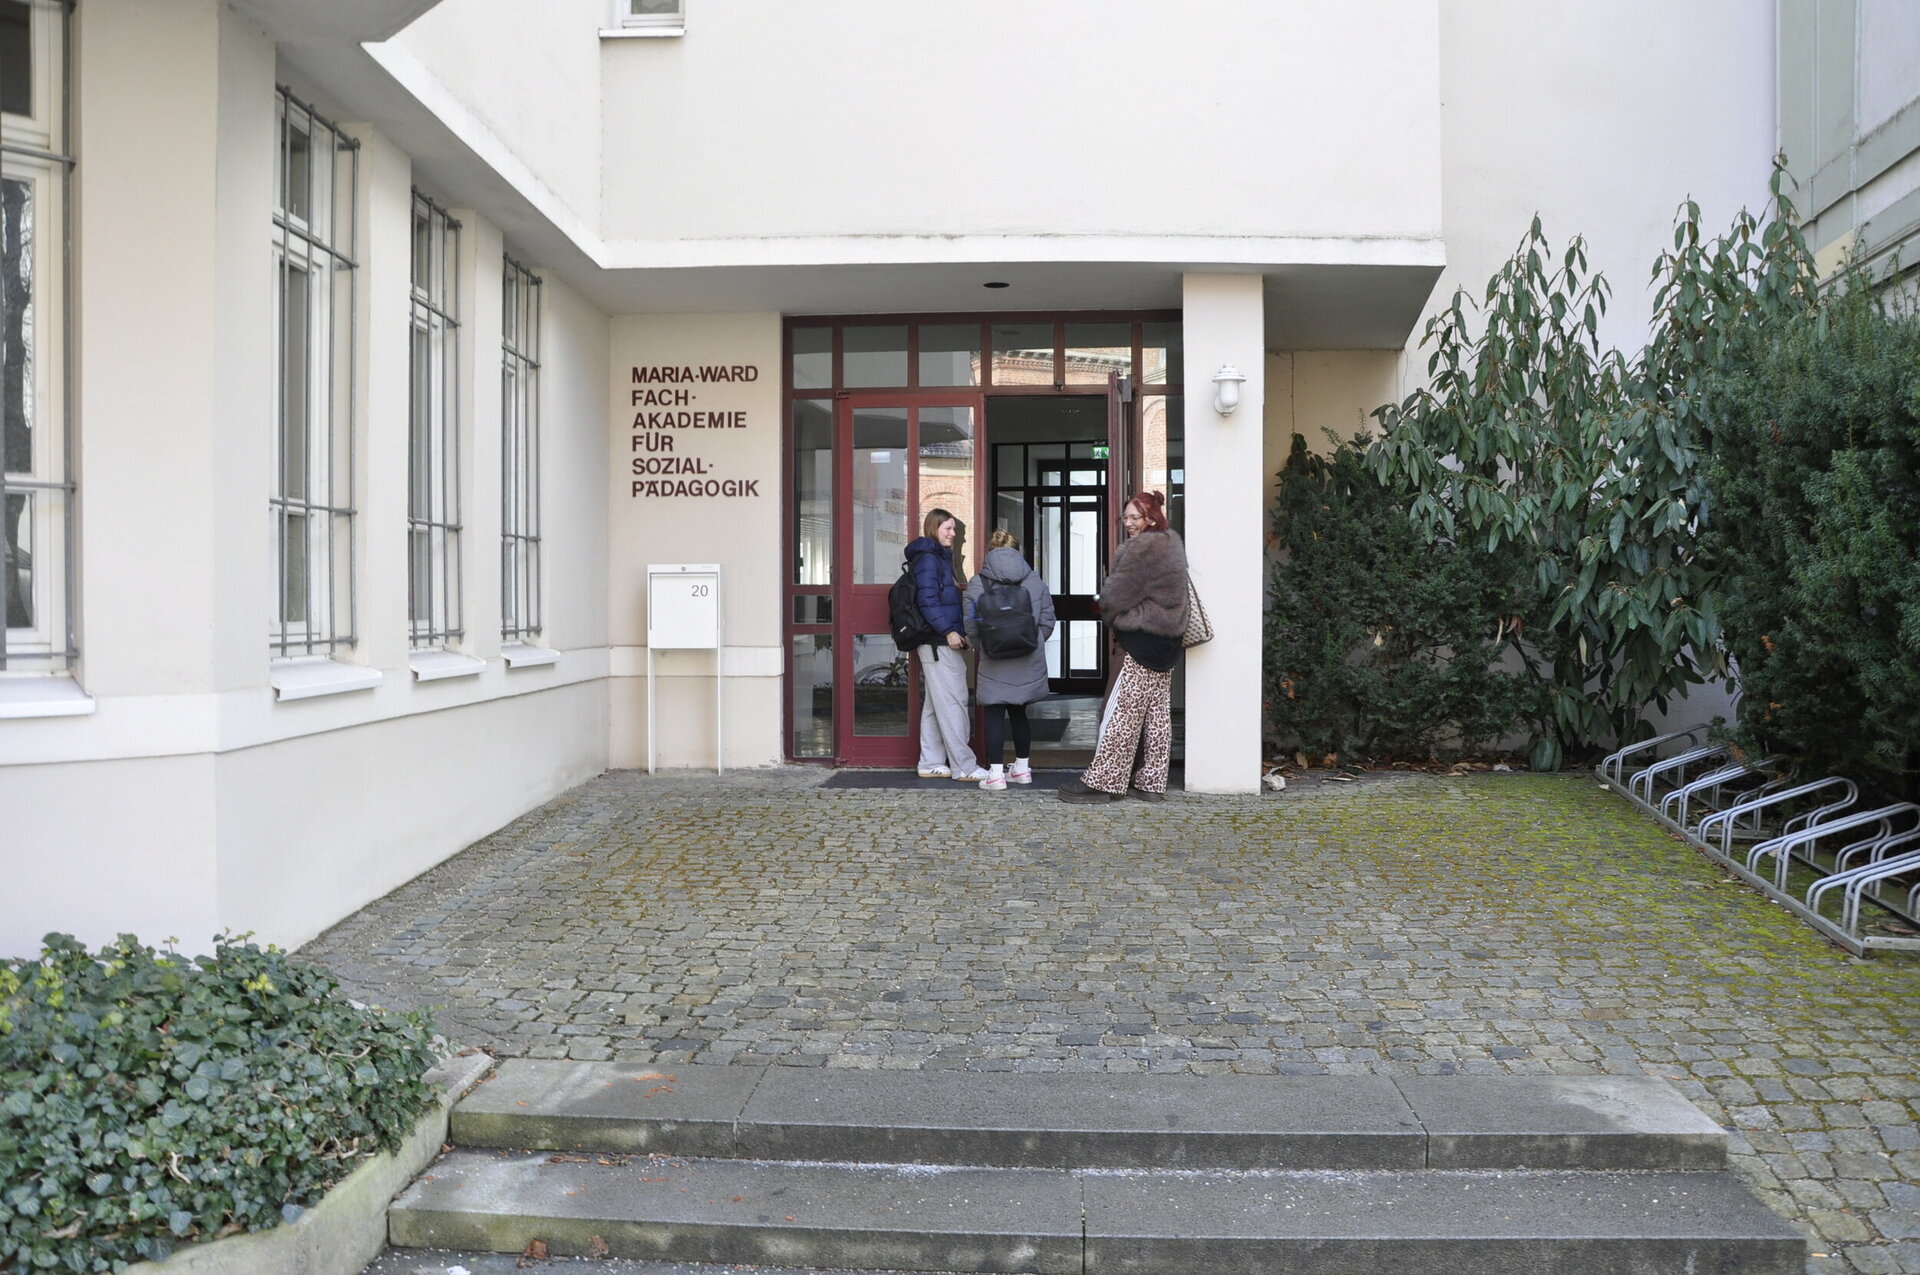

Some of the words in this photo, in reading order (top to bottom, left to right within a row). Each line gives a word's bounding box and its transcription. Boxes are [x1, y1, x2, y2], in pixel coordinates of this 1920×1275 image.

[632, 411, 747, 429] AKADEMIE
[632, 432, 674, 452] FÜR
[632, 480, 760, 497] PÄDAGOGIK
[691, 584, 709, 597] 20
